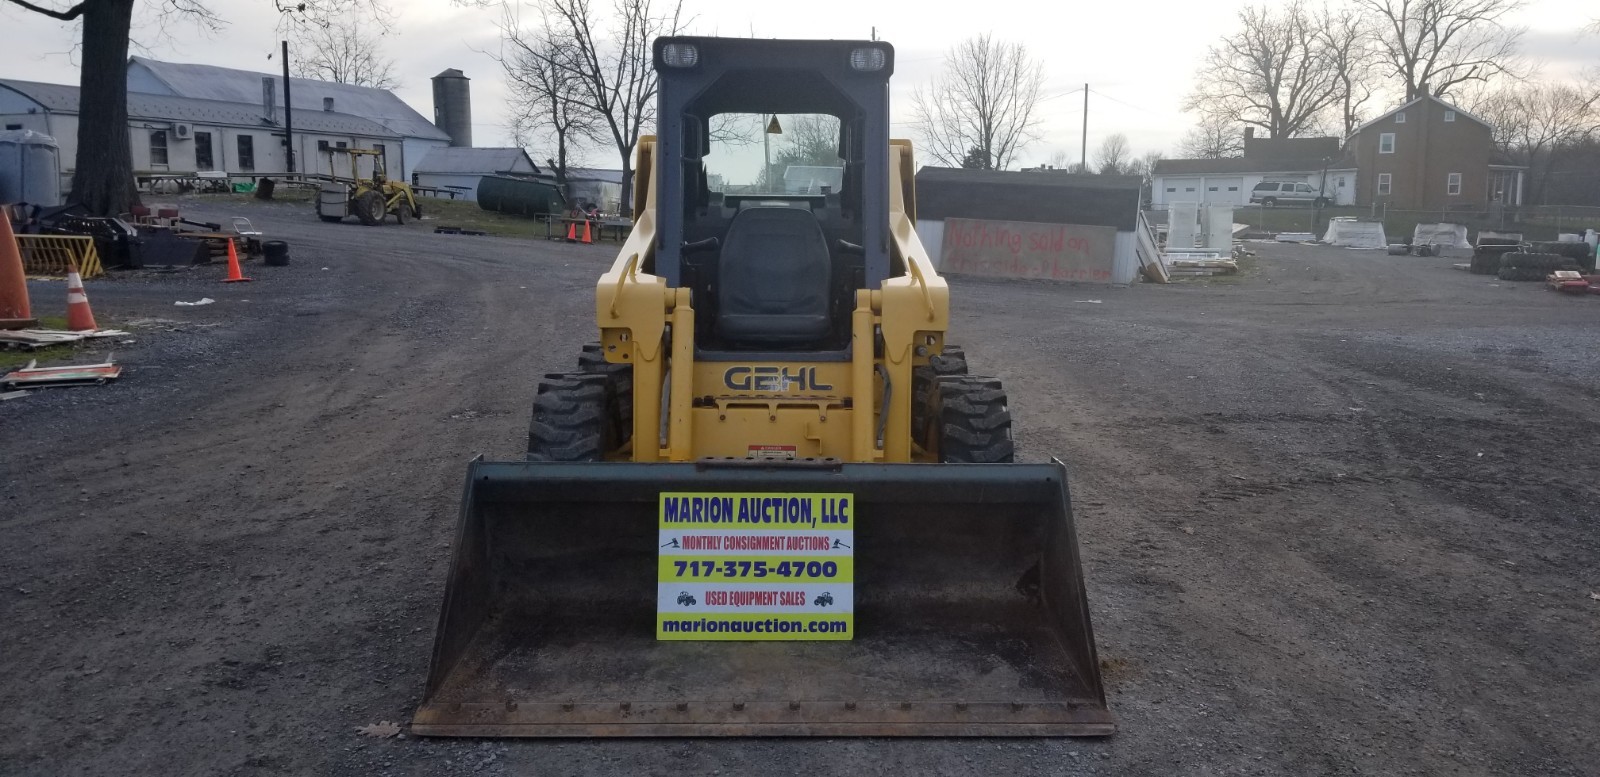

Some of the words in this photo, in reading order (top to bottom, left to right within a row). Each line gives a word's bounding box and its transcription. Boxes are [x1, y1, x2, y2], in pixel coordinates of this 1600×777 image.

[948, 223, 1022, 253] Nothing
[1028, 226, 1066, 253] sold
[1068, 236, 1090, 255] on
[723, 365, 833, 391] GEHL
[664, 497, 733, 523] MARION
[738, 497, 817, 528] AUCTION,
[821, 498, 849, 523] LLC
[682, 536, 722, 550] MONTHLY
[724, 536, 785, 551] CONSIGNMENT
[787, 536, 830, 551] AUCTIONS
[674, 560, 838, 578] 717-375-4700
[705, 591, 728, 606] USED
[729, 591, 779, 607] EQUIPMENT
[780, 591, 806, 606] SALES
[662, 618, 847, 633] marionauction.com
